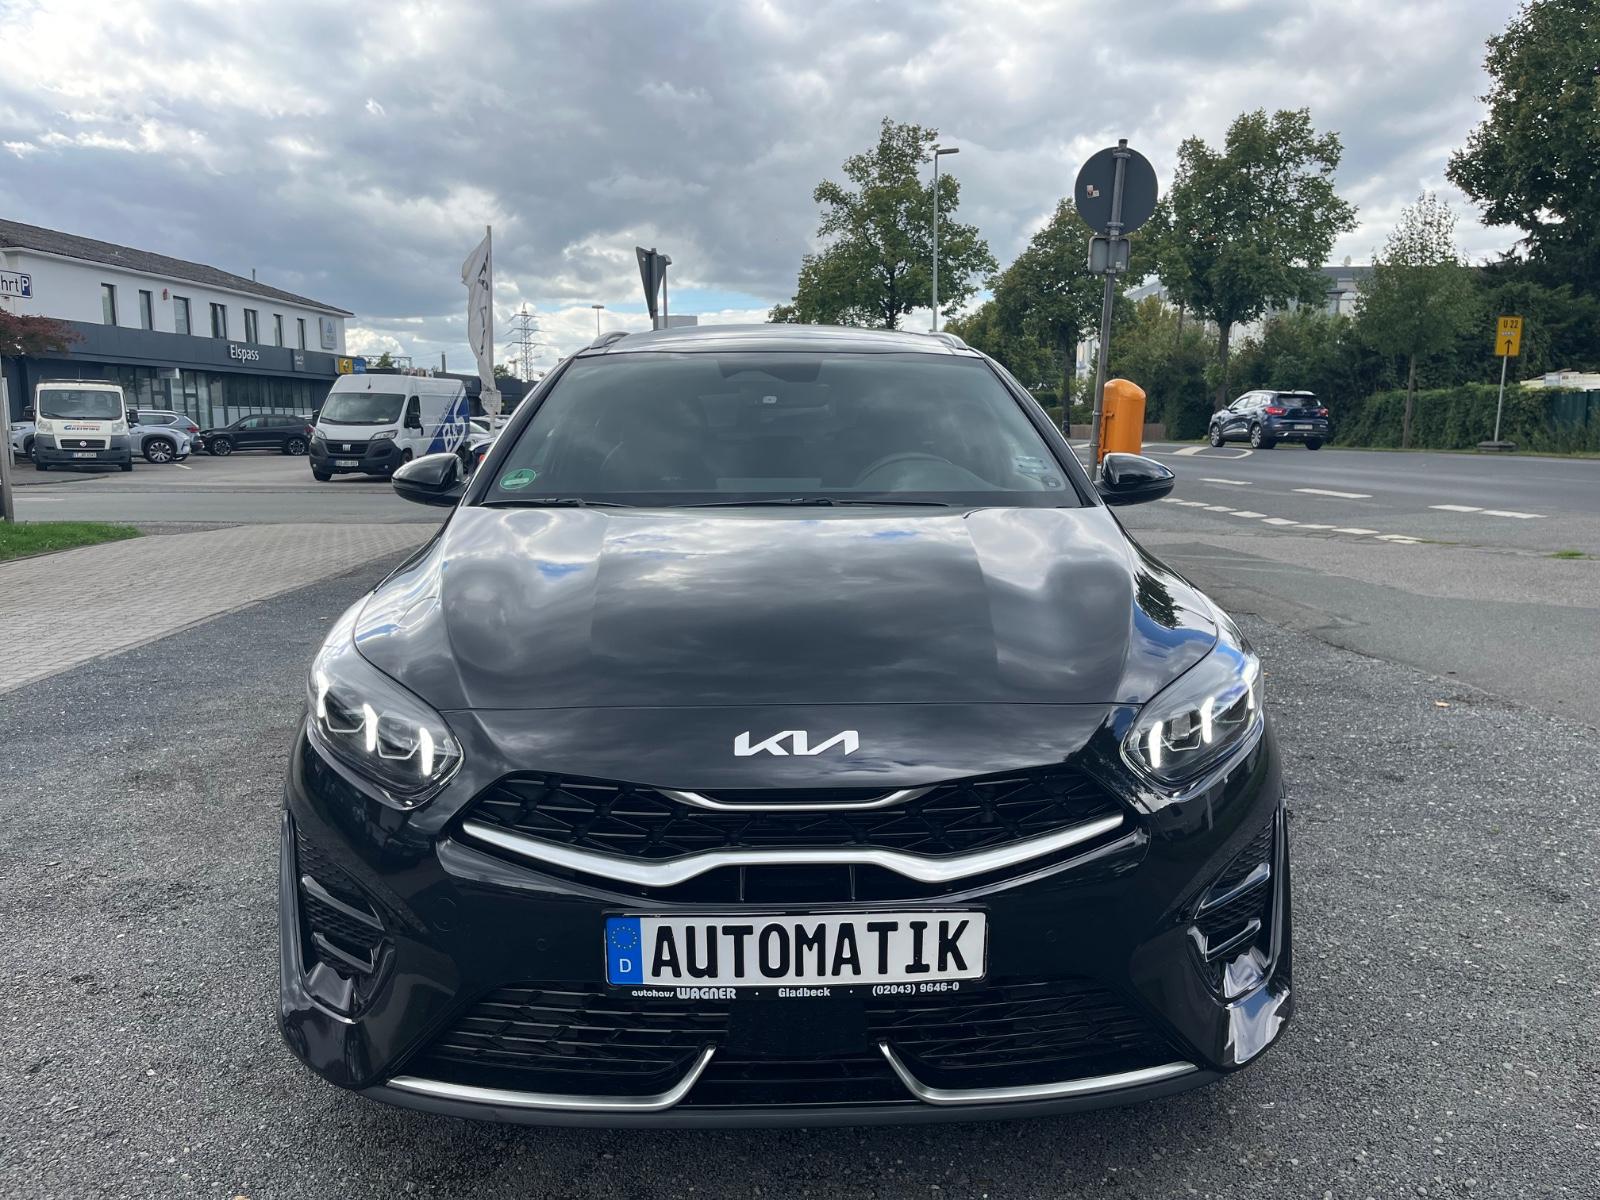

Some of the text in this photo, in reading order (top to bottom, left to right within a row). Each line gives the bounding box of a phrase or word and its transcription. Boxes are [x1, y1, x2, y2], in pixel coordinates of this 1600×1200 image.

[1503, 320, 1519, 329] U 22
[230, 344, 259, 363] Elspass
[734, 730, 861, 757] KIA
[619, 919, 970, 979] D AUTOMATIK
[631, 982, 960, 1000] autohaus WAGNER Gladbeck (02043) 9646-0
